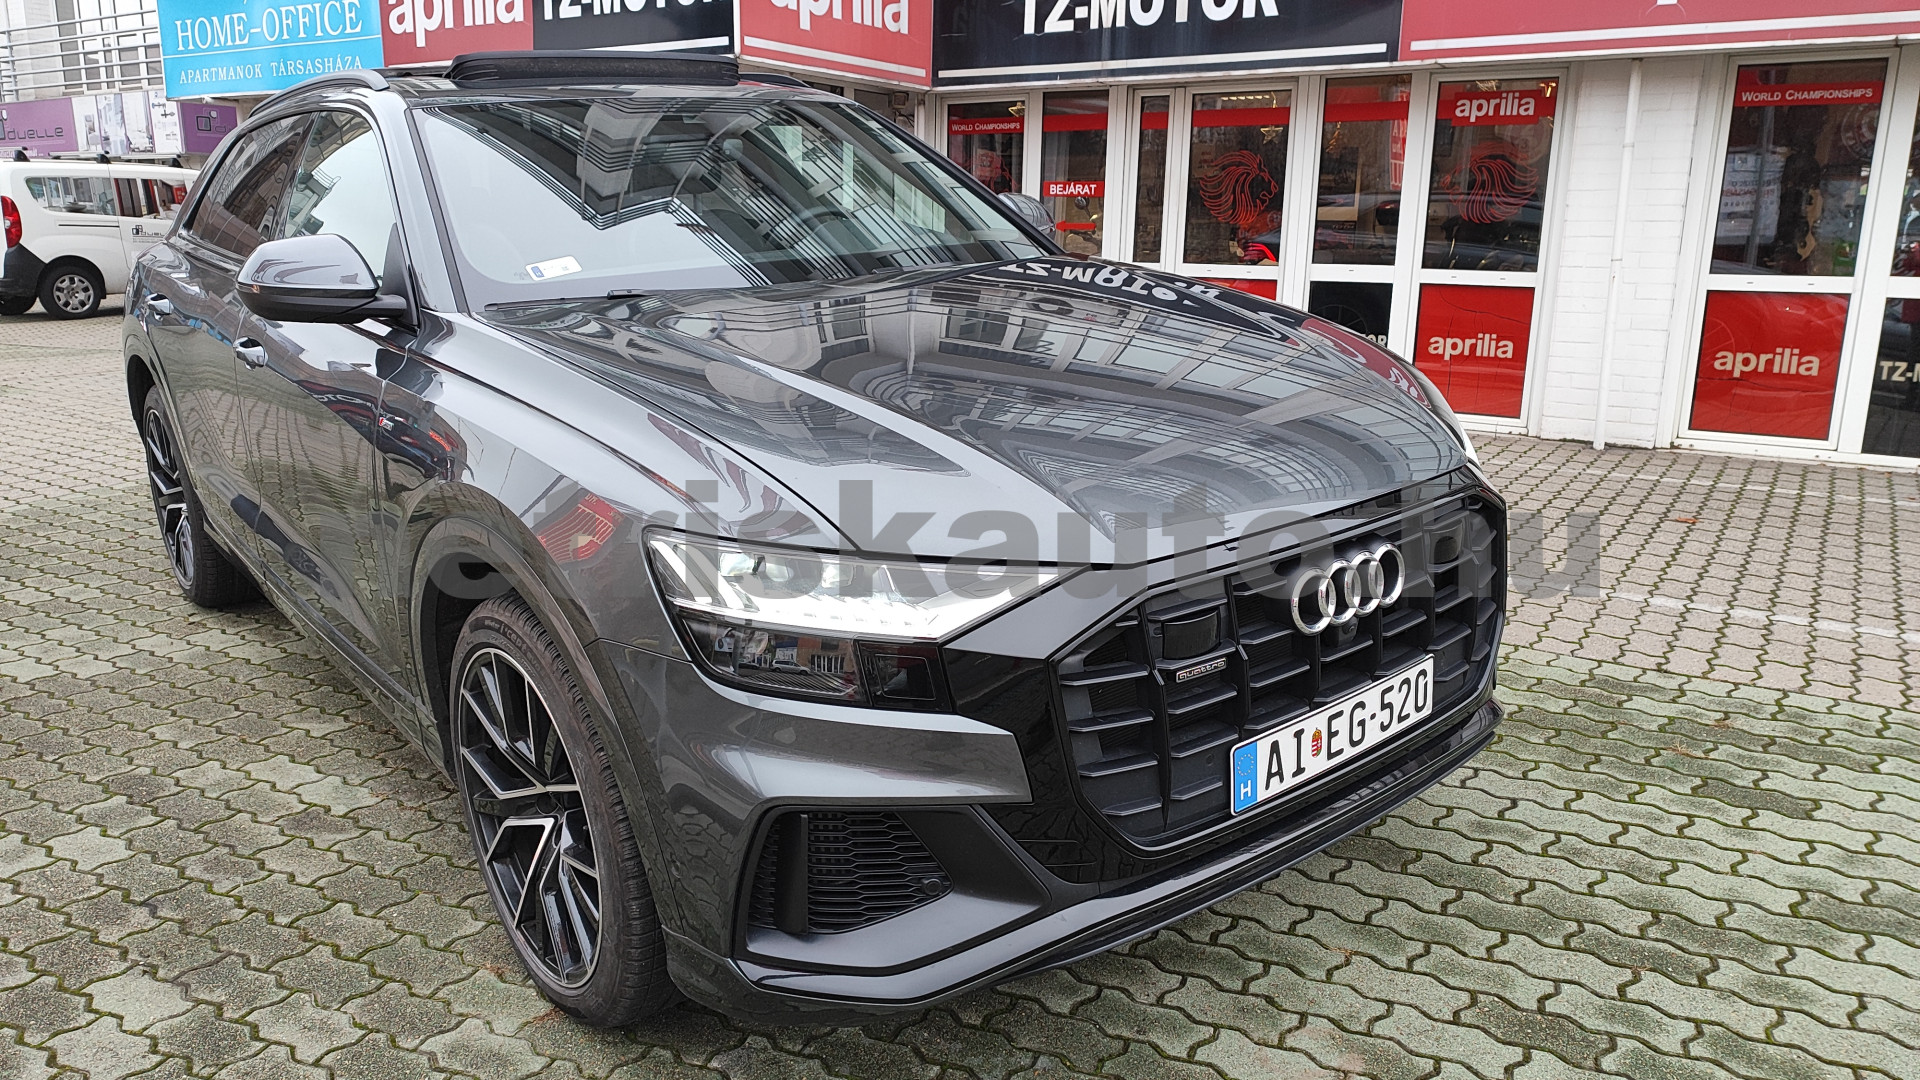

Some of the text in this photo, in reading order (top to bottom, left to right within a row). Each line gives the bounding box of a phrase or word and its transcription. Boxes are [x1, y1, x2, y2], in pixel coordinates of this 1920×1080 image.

[174, 0, 363, 51] HOME-OFFICE
[179, 54, 363, 84] APARTMANOK TÁRSASHÁZA
[1454, 92, 1535, 122] aprilia
[1049, 182, 1097, 195] BEJÁRAT
[1428, 333, 1513, 361] aprilia
[1713, 347, 1821, 377] aprilia
[1179, 661, 1225, 680] quattro
[1264, 668, 1428, 791] AI EG-520
[1240, 779, 1252, 801] H
